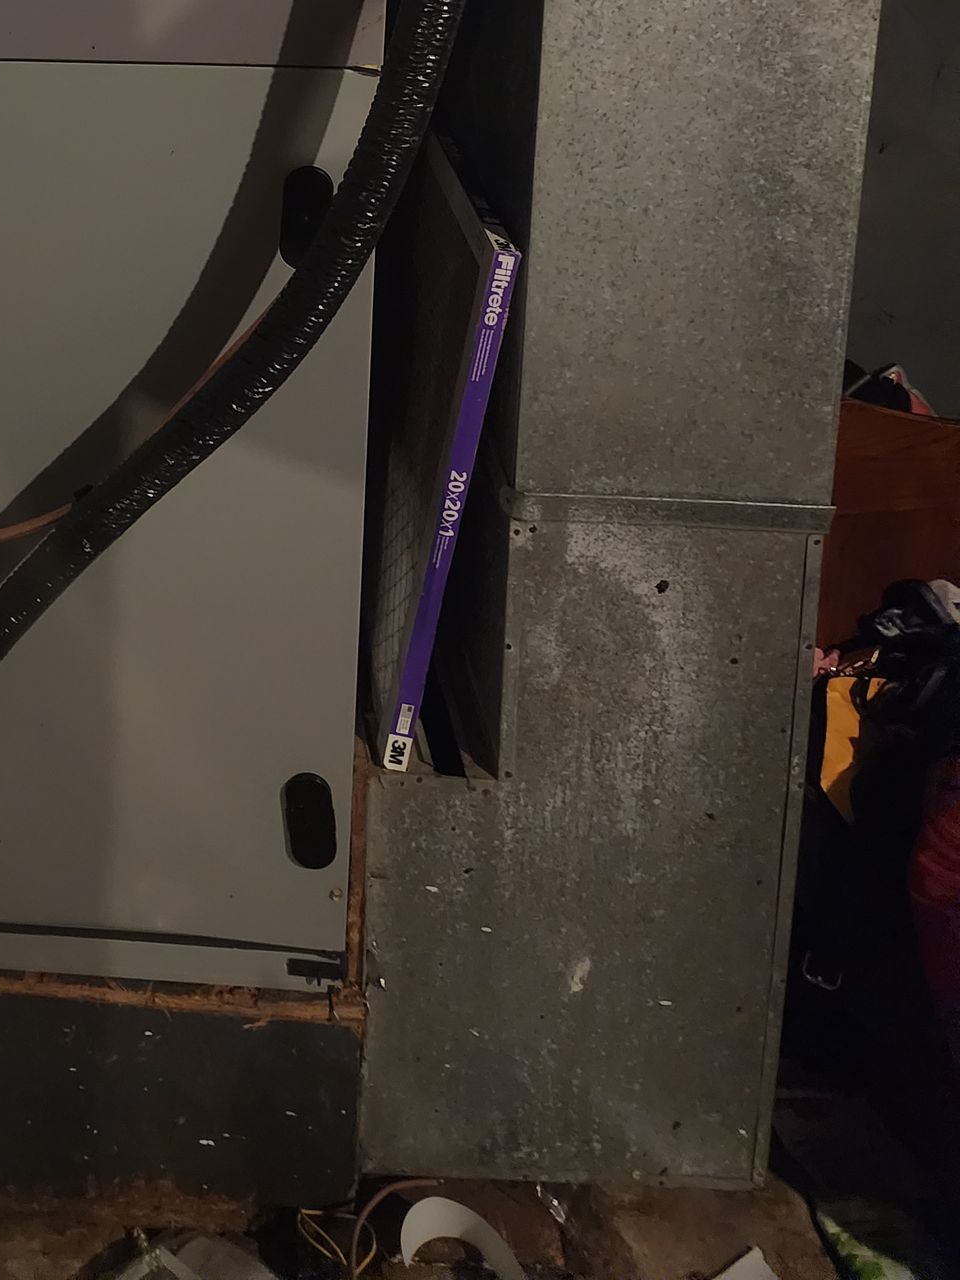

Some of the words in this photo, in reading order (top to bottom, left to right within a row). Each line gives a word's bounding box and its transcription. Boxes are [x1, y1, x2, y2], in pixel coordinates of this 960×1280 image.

[484, 254, 515, 326] Filtrete
[438, 470, 467, 537] 20x20x1
[389, 740, 406, 765] 3M
